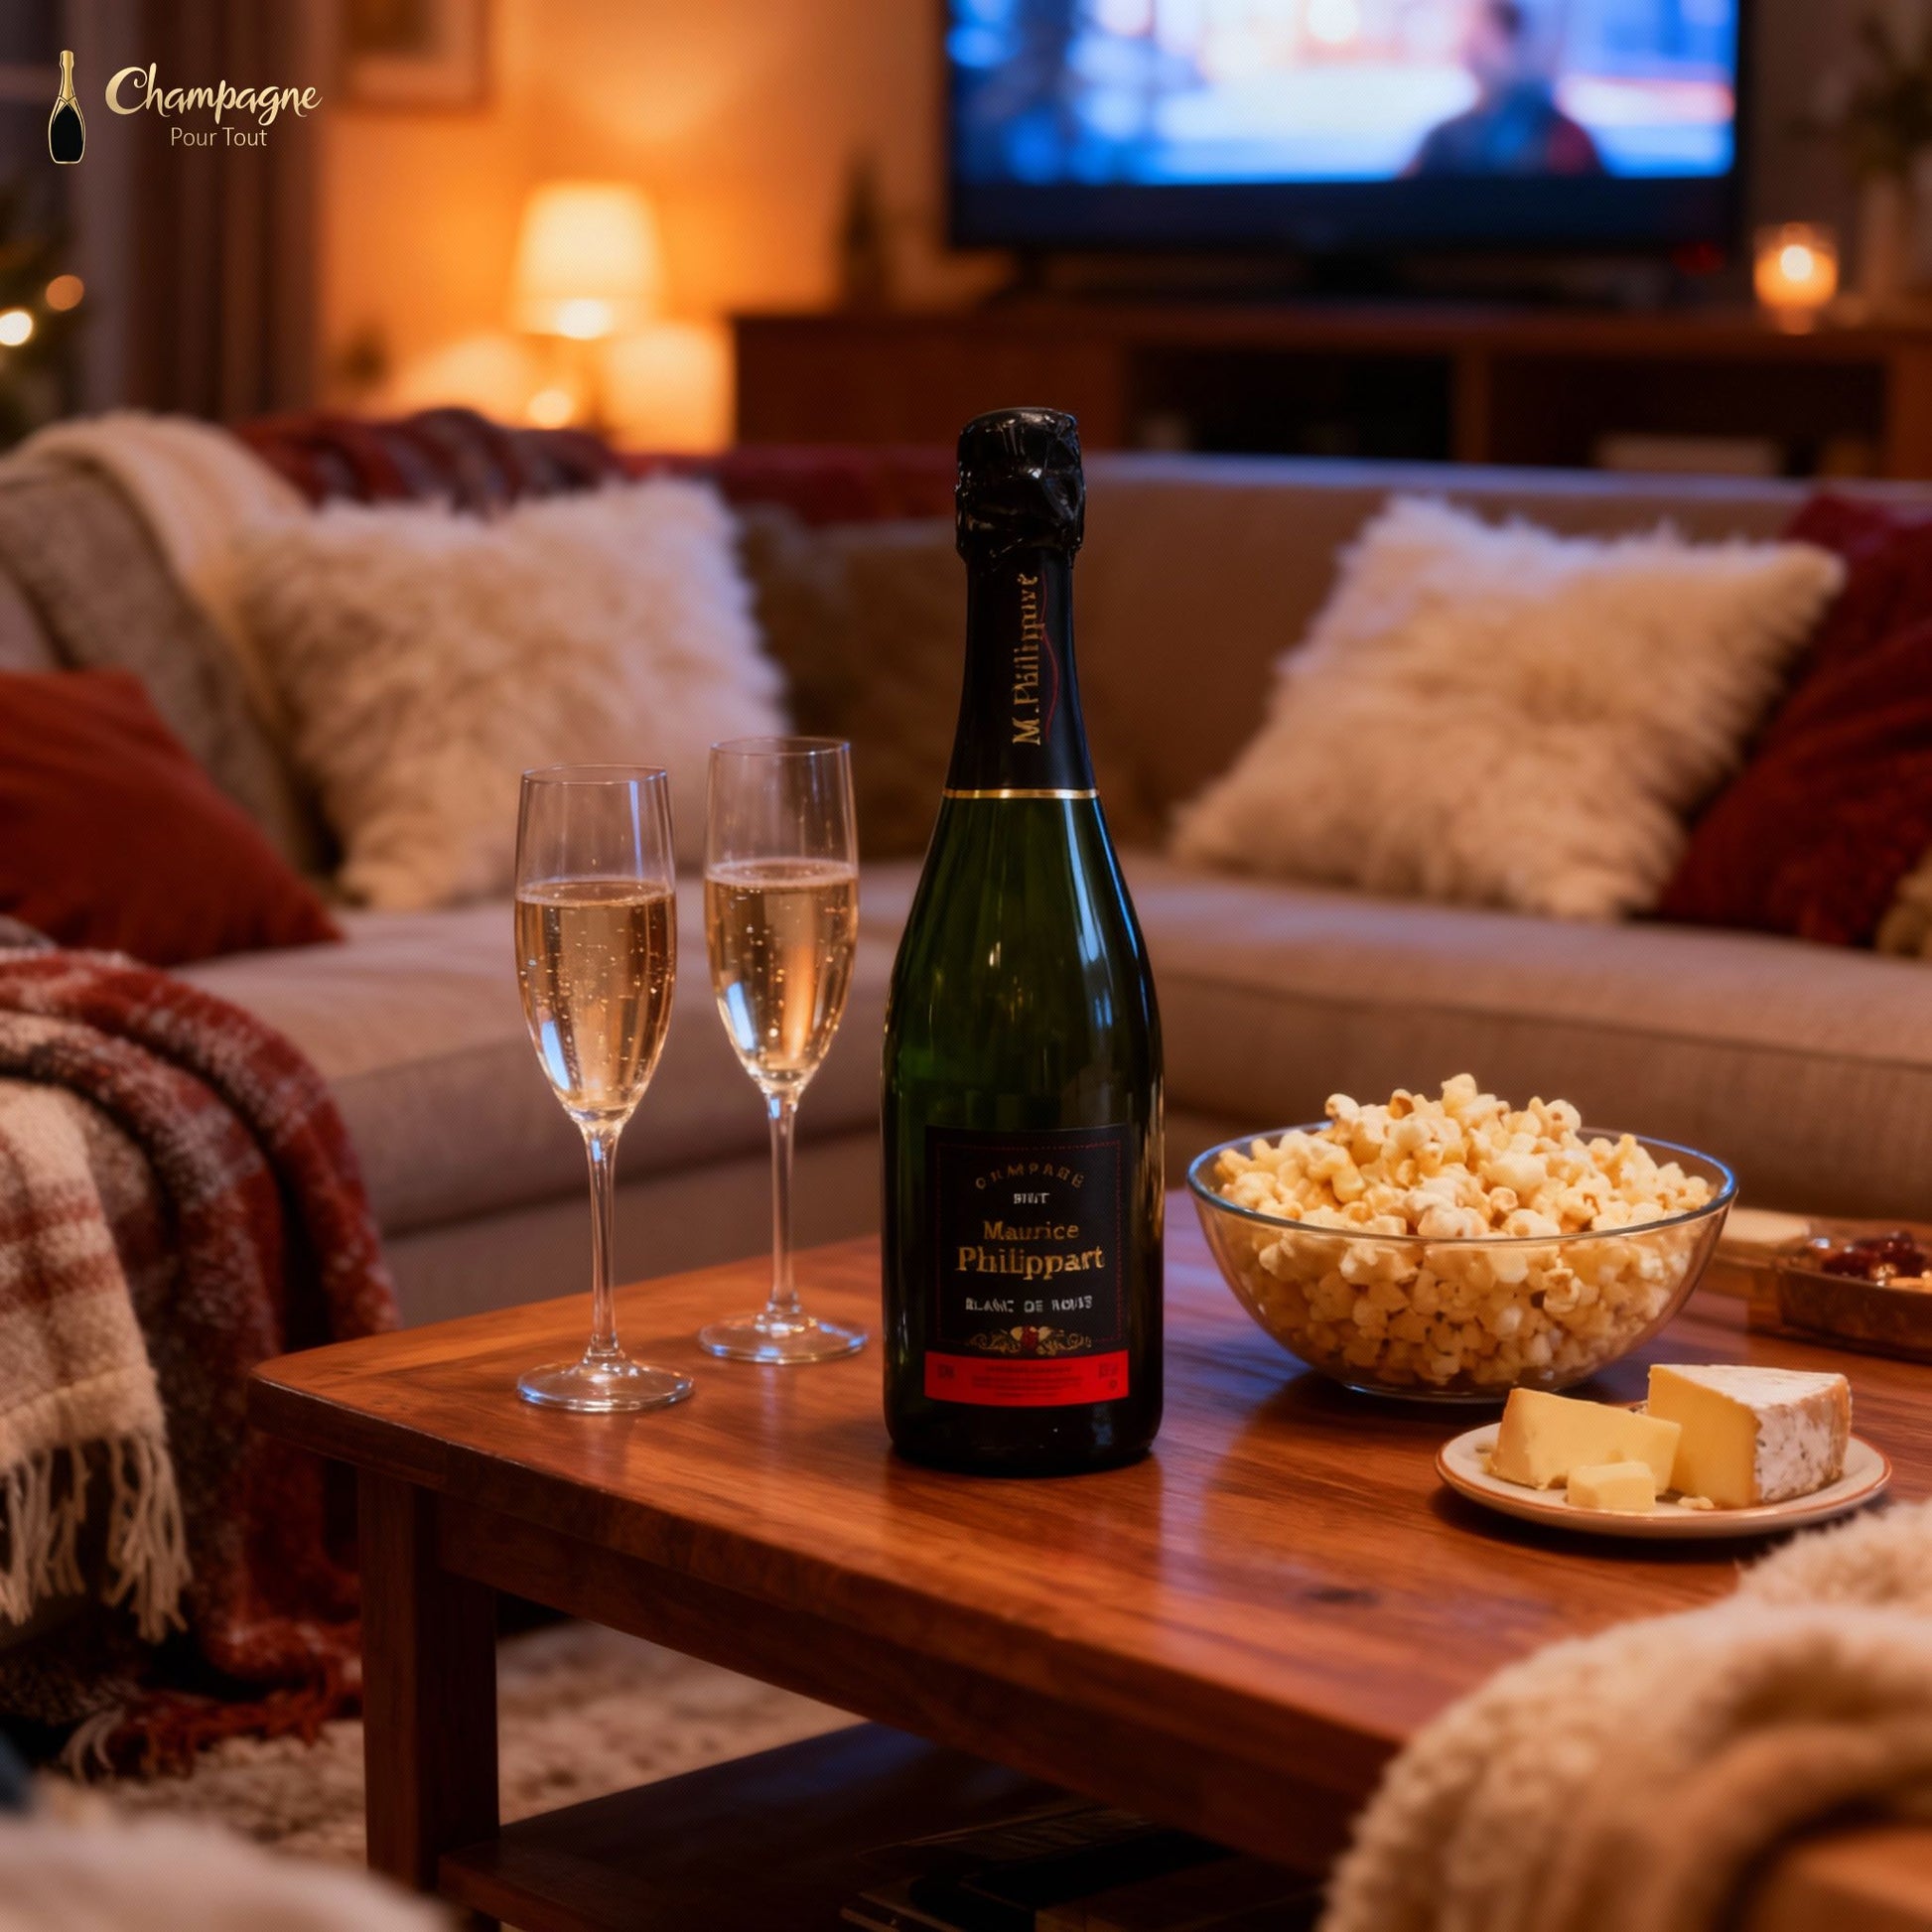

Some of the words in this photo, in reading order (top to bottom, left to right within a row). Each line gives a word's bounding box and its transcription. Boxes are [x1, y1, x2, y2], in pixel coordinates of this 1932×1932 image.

[983, 1220, 1080, 1241] Maurice
[954, 1245, 1106, 1281] Philippart
[1024, 1300, 1043, 1313] DE
